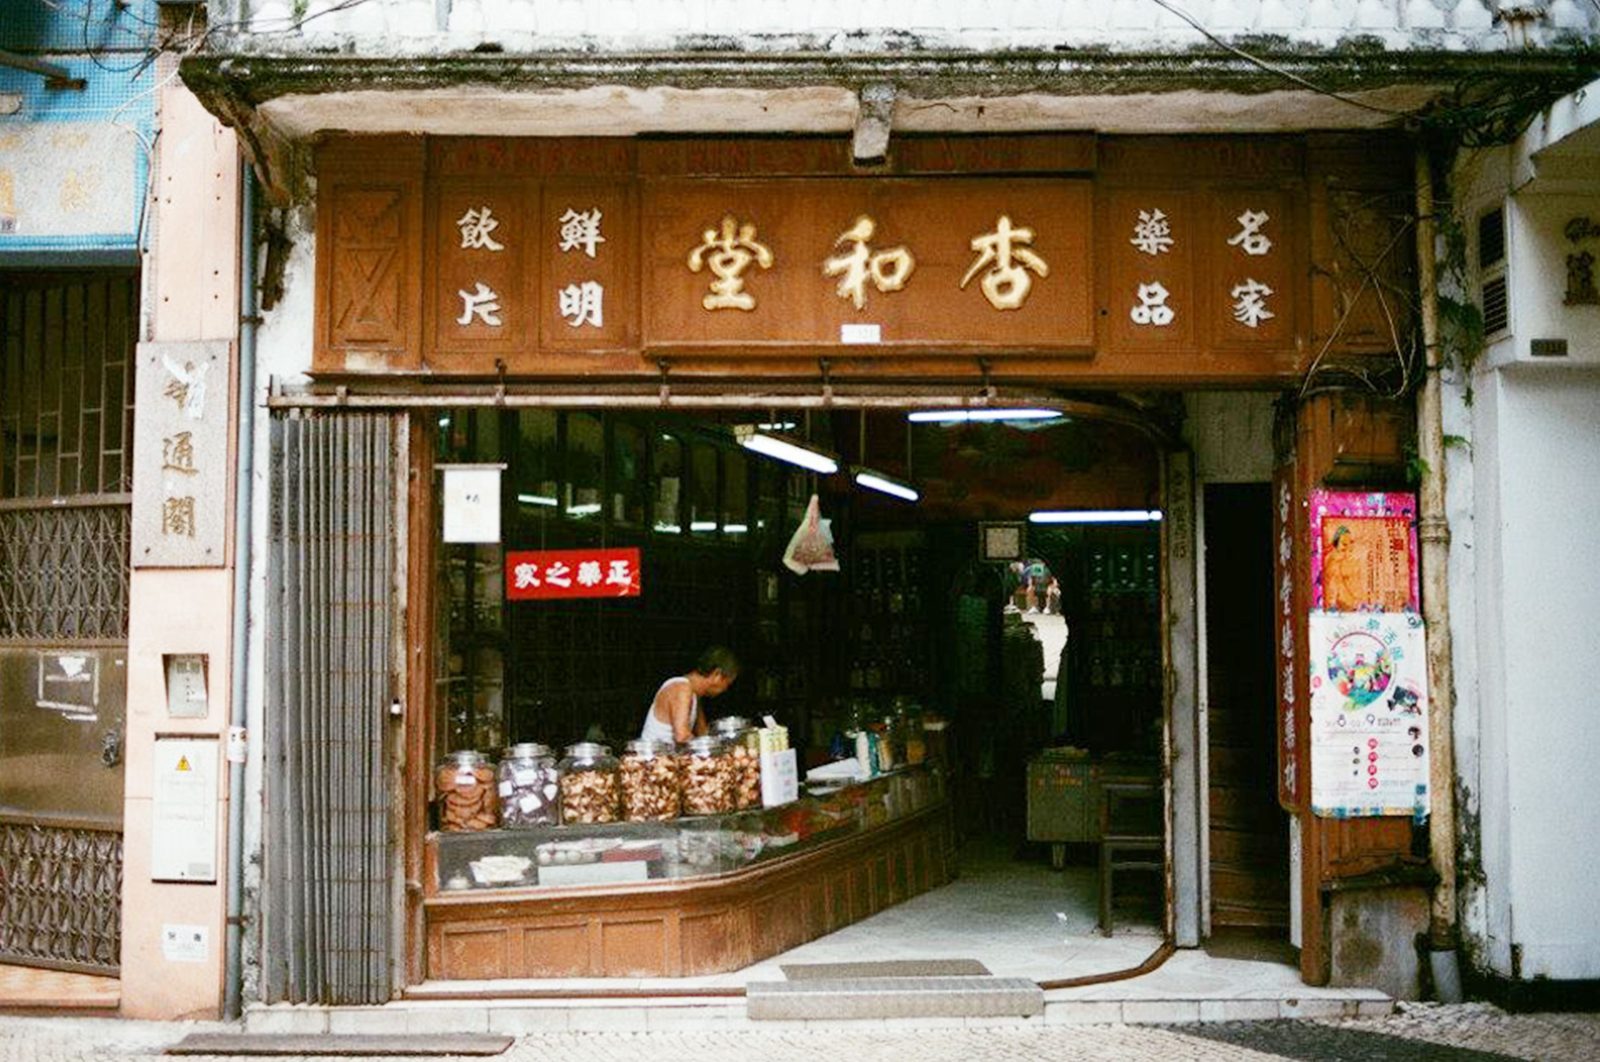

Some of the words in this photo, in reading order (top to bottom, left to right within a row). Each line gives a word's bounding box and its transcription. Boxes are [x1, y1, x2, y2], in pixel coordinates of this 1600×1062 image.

[456, 206, 504, 327] 飲片
[558, 207, 606, 328] 鮮明
[687, 215, 1049, 311] 杏和堂
[1130, 208, 1175, 326] 藥品
[1227, 208, 1276, 328] 名家
[514, 560, 632, 590] 正藥之家
